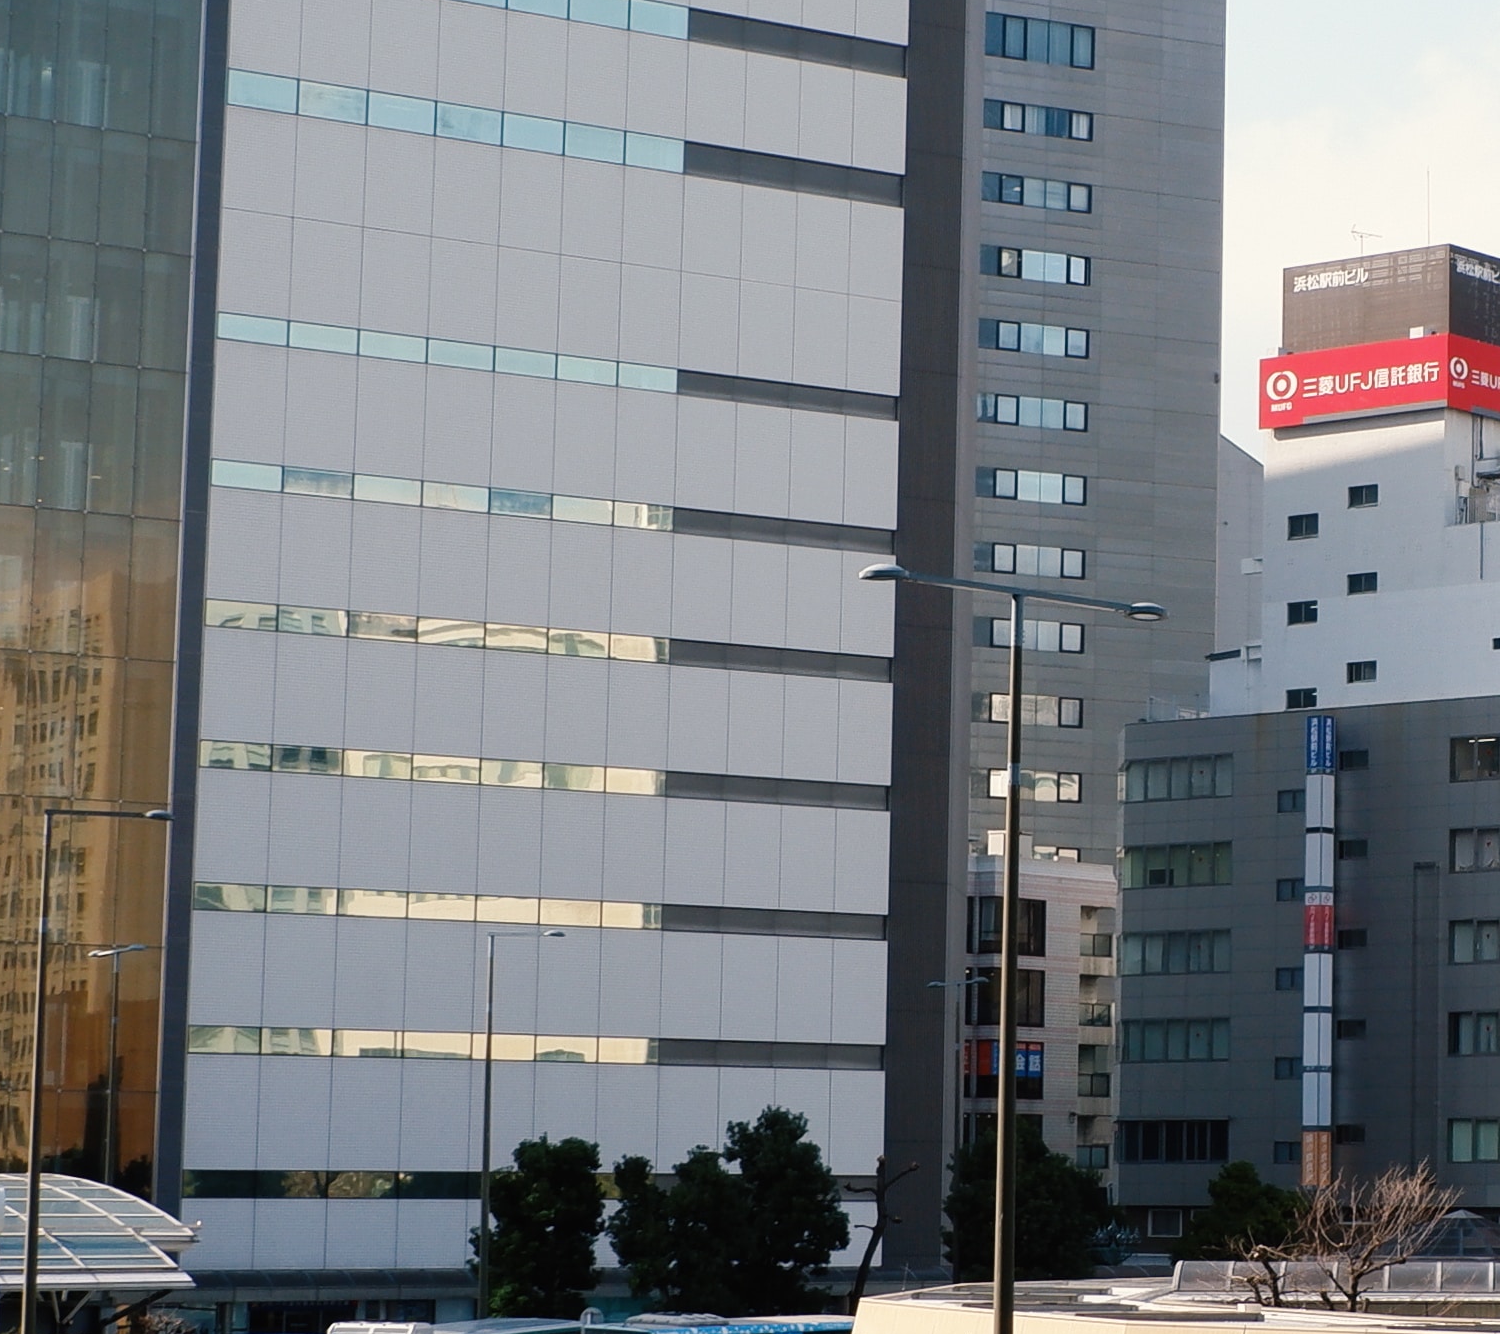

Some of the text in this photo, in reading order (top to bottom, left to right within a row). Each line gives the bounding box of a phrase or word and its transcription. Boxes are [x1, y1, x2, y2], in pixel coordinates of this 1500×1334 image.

[1293, 267, 1369, 292] 浜松駅前ビル
[1303, 362, 1440, 398] 三菱UFJ信託銀行
